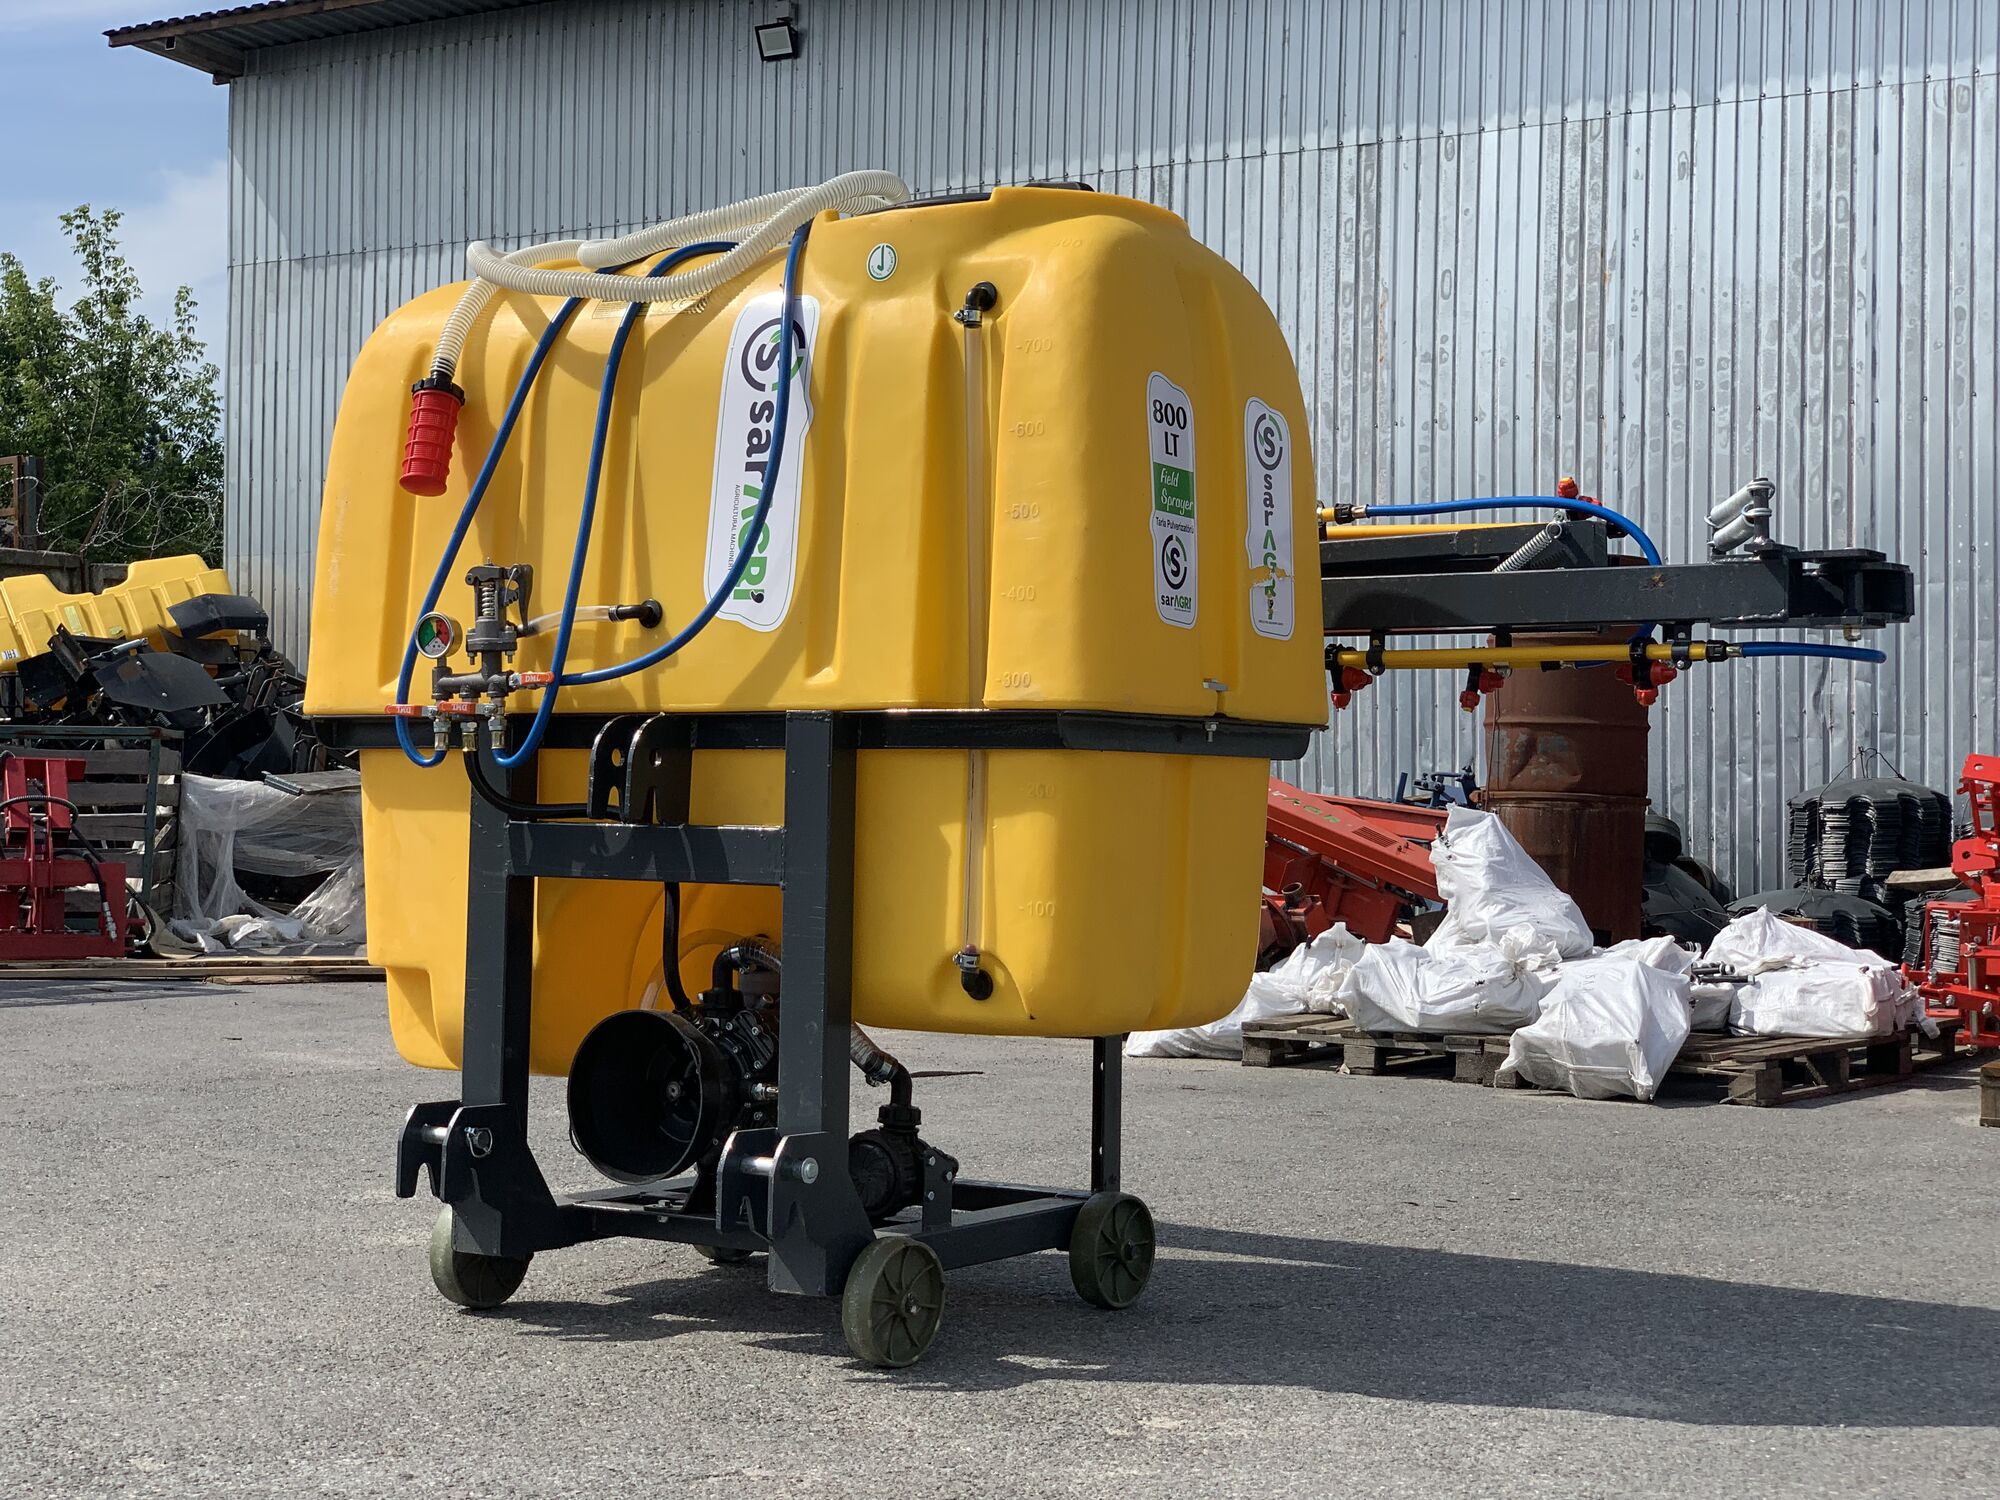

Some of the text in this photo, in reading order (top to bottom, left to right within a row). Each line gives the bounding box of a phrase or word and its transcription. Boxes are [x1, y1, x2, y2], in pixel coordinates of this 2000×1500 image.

[1153, 399, 1187, 430] 800
[1164, 431, 1179, 457] LT
[1160, 467, 1179, 487] Field
[731, 484, 741, 530] AGRICULTURAL
[1160, 487, 1194, 515] Sprayer
